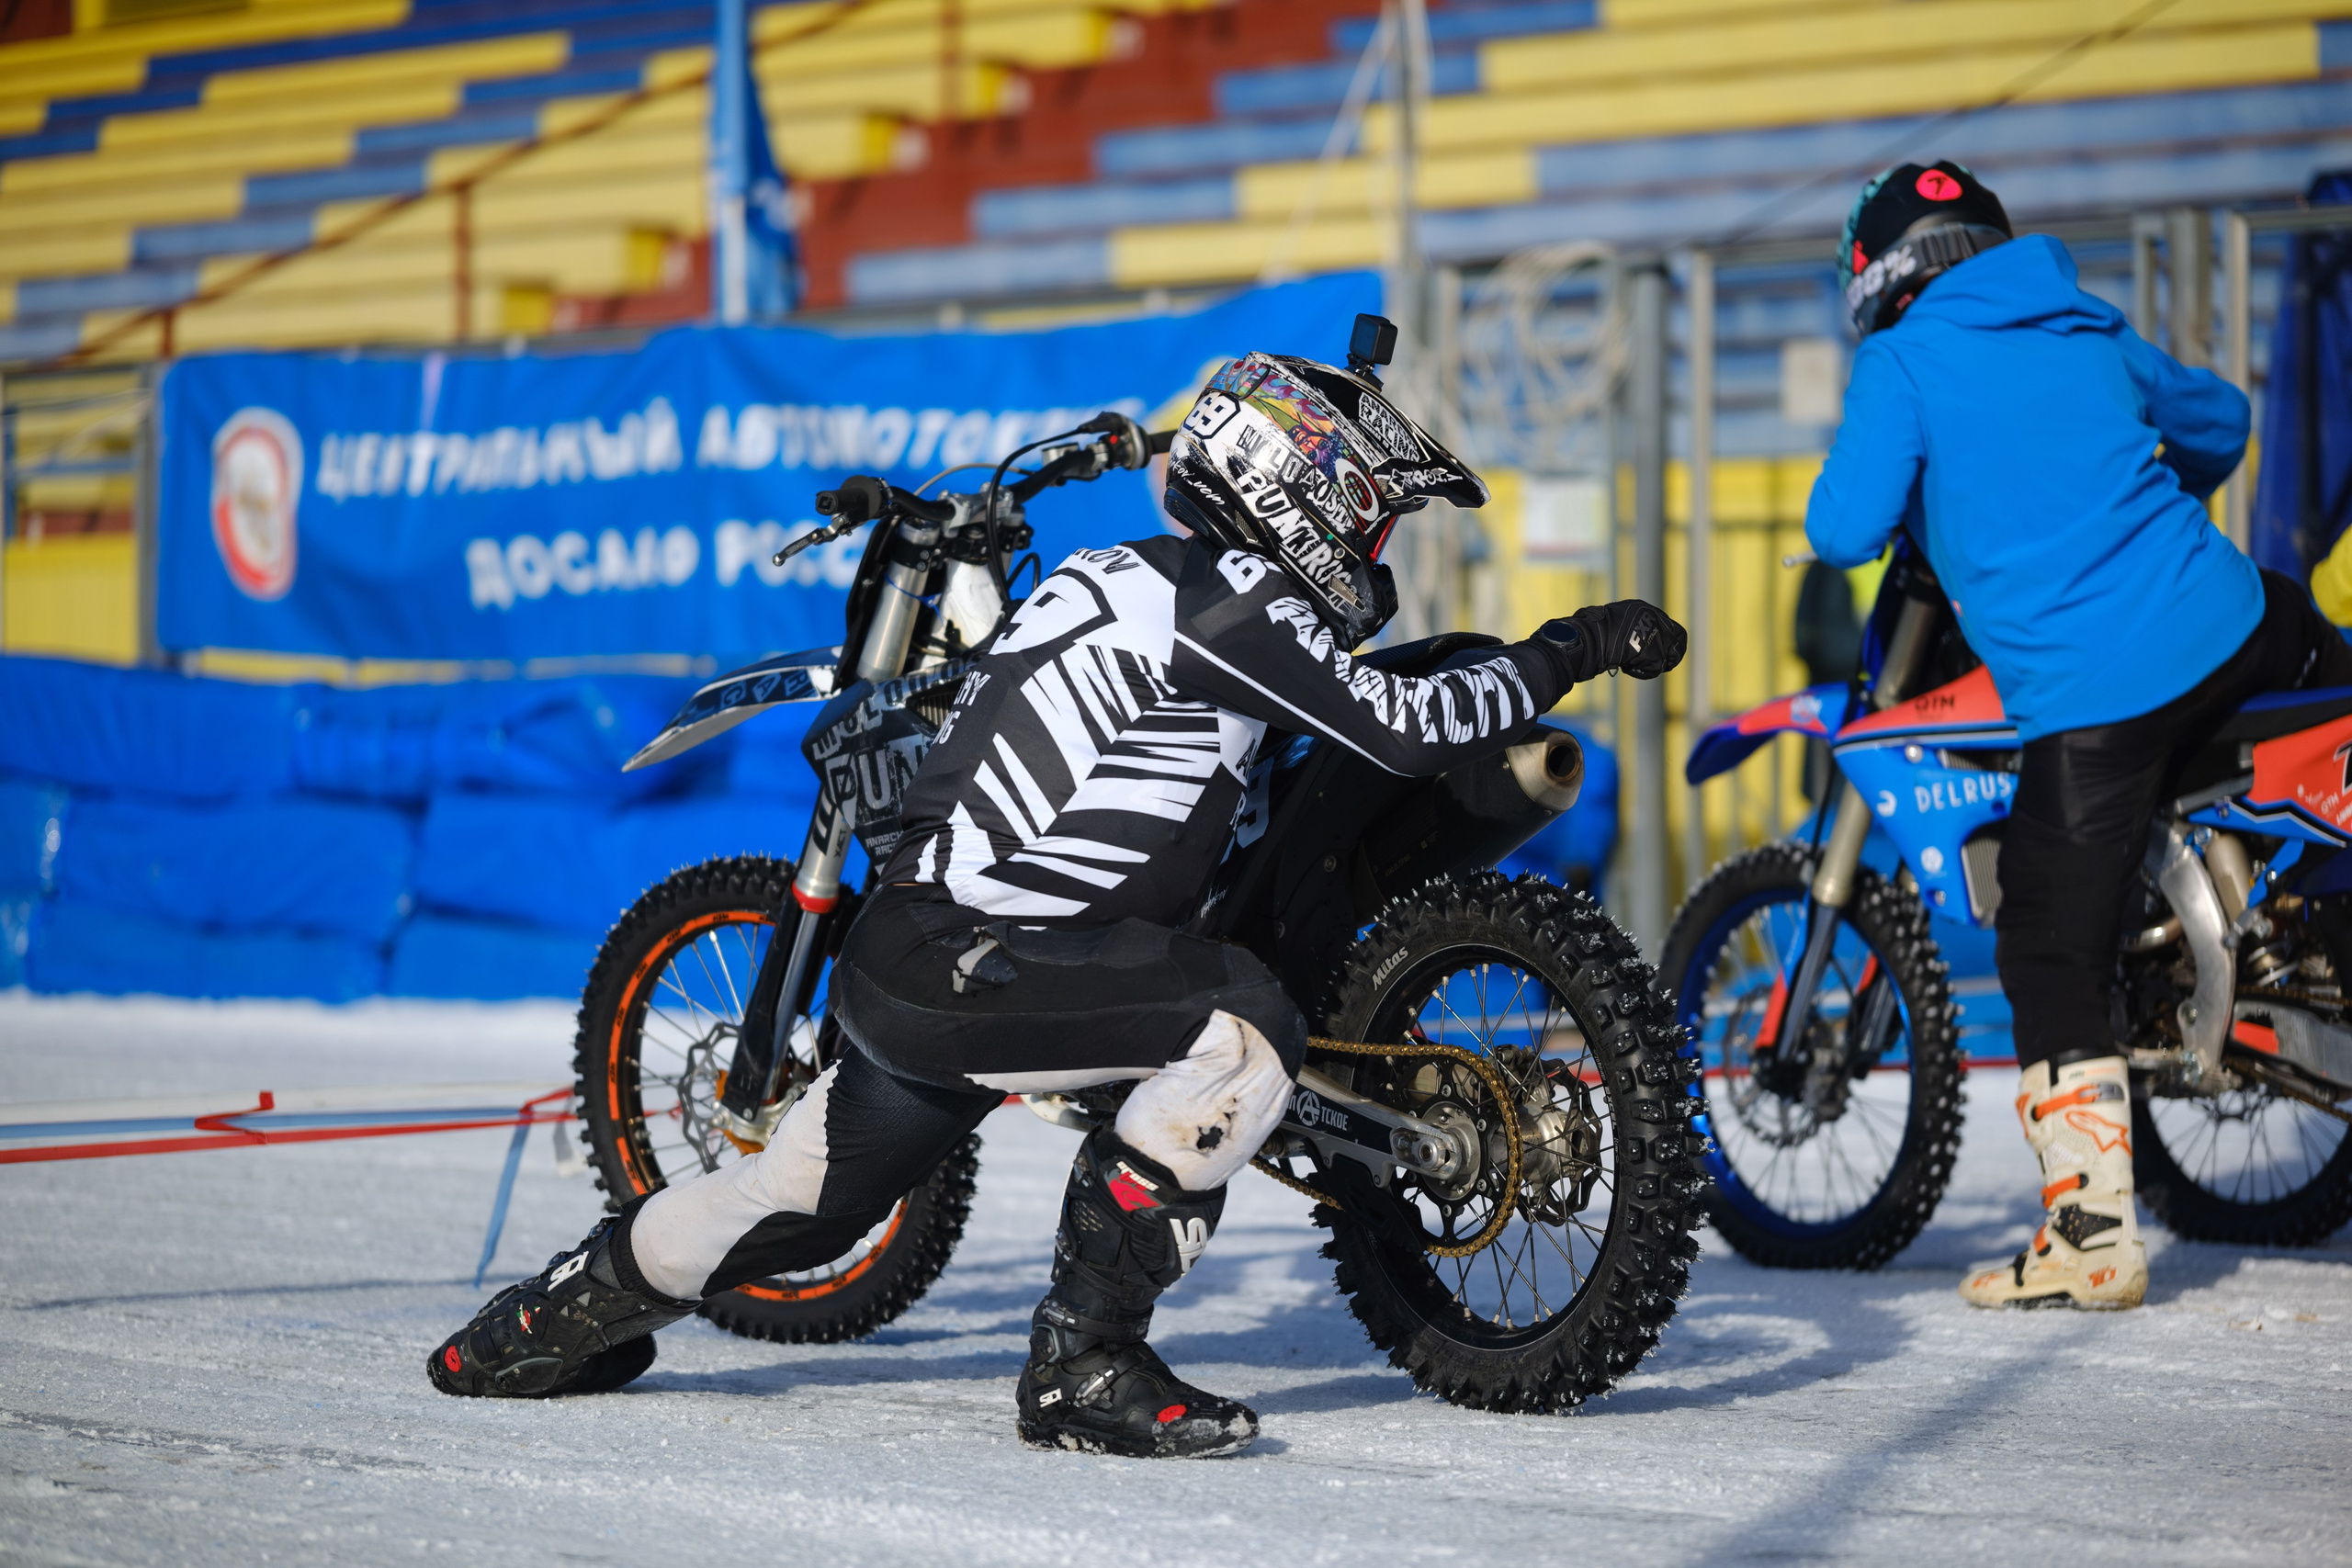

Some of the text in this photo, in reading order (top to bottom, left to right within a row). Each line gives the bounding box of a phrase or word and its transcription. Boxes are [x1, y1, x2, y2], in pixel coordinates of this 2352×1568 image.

[1914, 772, 2013, 814] DELRUS
[865, 829, 906, 849] ANARCH
[1372, 946, 1408, 991] Mitas
